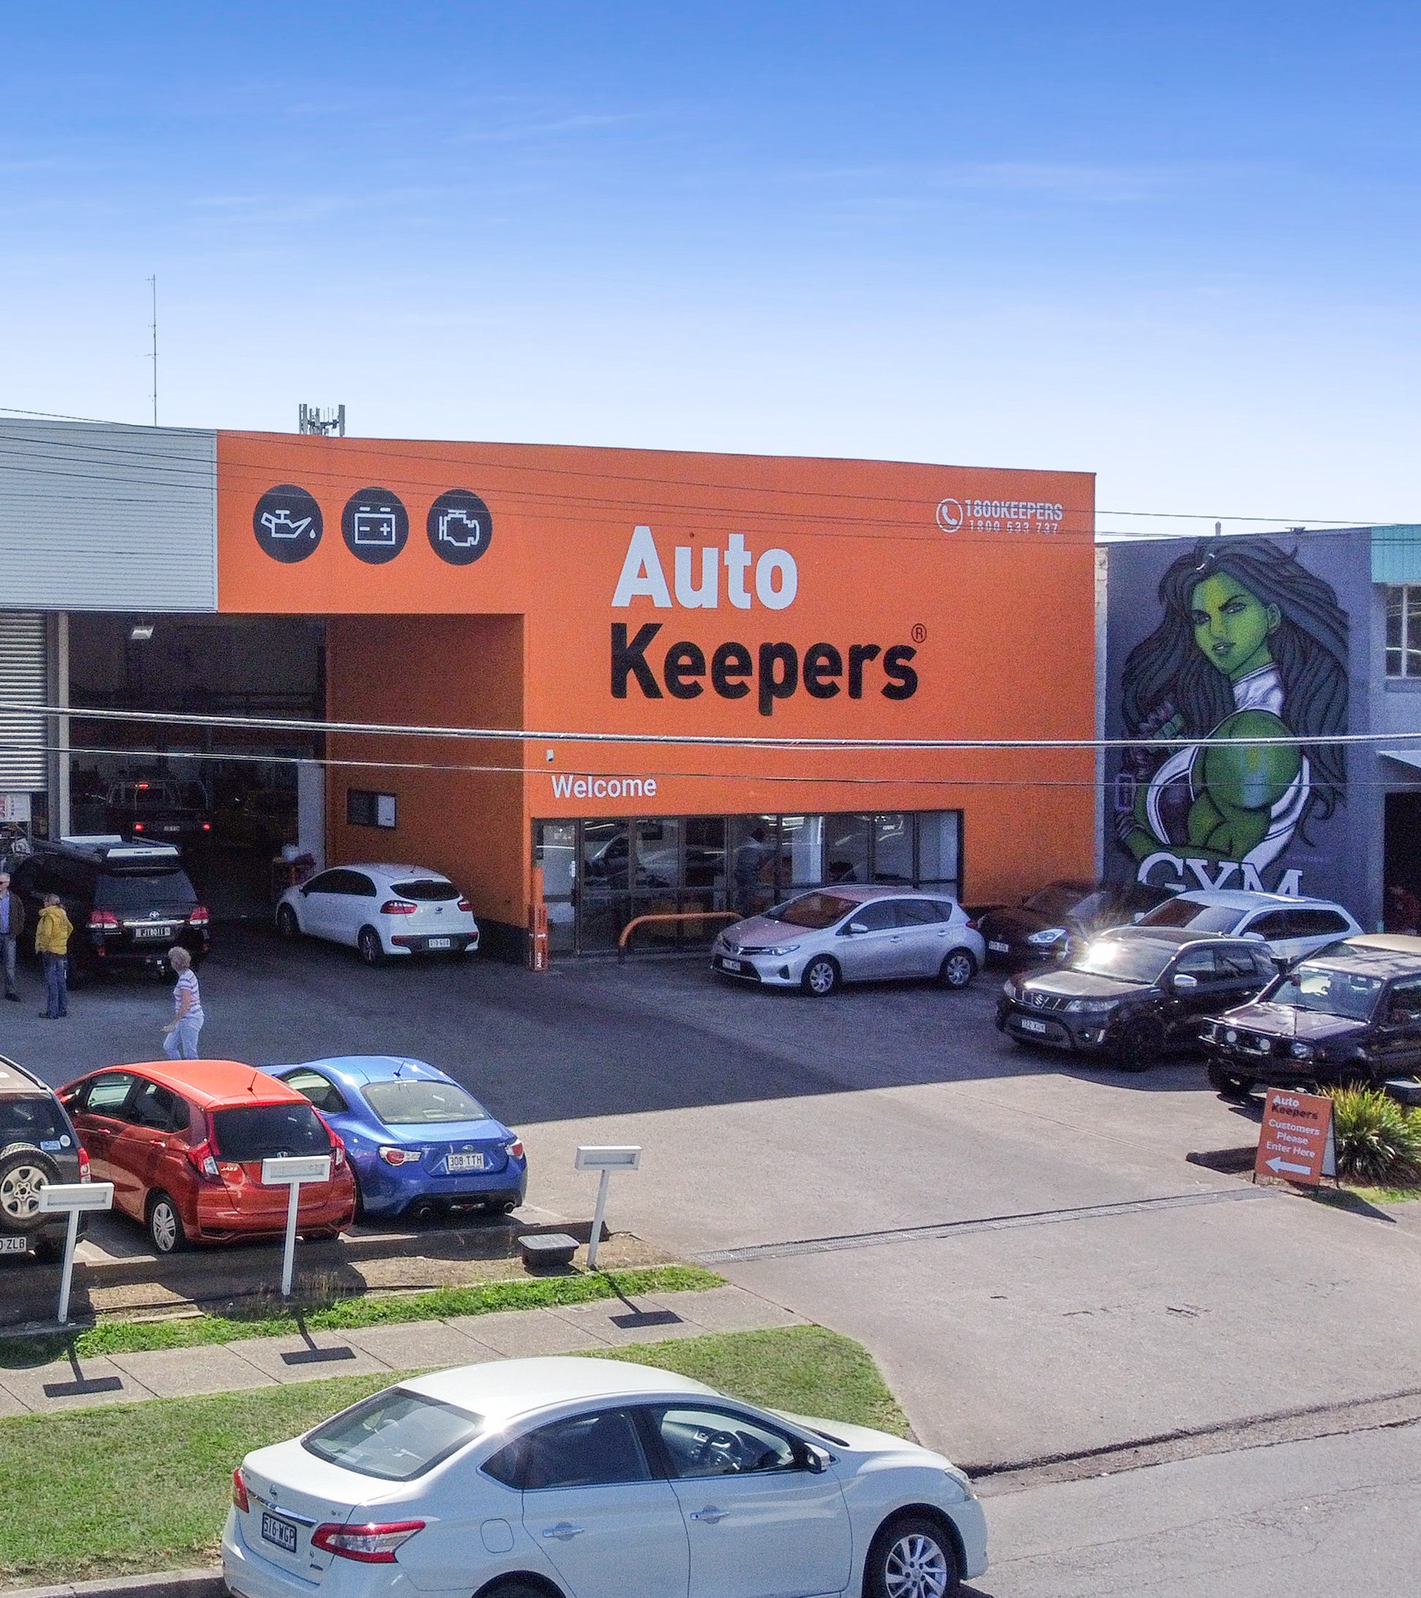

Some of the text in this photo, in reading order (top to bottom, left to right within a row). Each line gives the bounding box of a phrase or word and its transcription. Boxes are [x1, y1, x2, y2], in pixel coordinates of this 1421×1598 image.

[965, 500, 1063, 521] 1800KEEPERS
[611, 525, 798, 610] Auto
[610, 622, 919, 717] Keepers
[551, 773, 657, 799] Welcome
[1272, 1095, 1299, 1107] Auto
[1271, 1104, 1318, 1120] Keepers
[1268, 1119, 1321, 1136] Customers
[1276, 1131, 1309, 1145] Please
[1266, 1141, 1316, 1158] Enter Here
